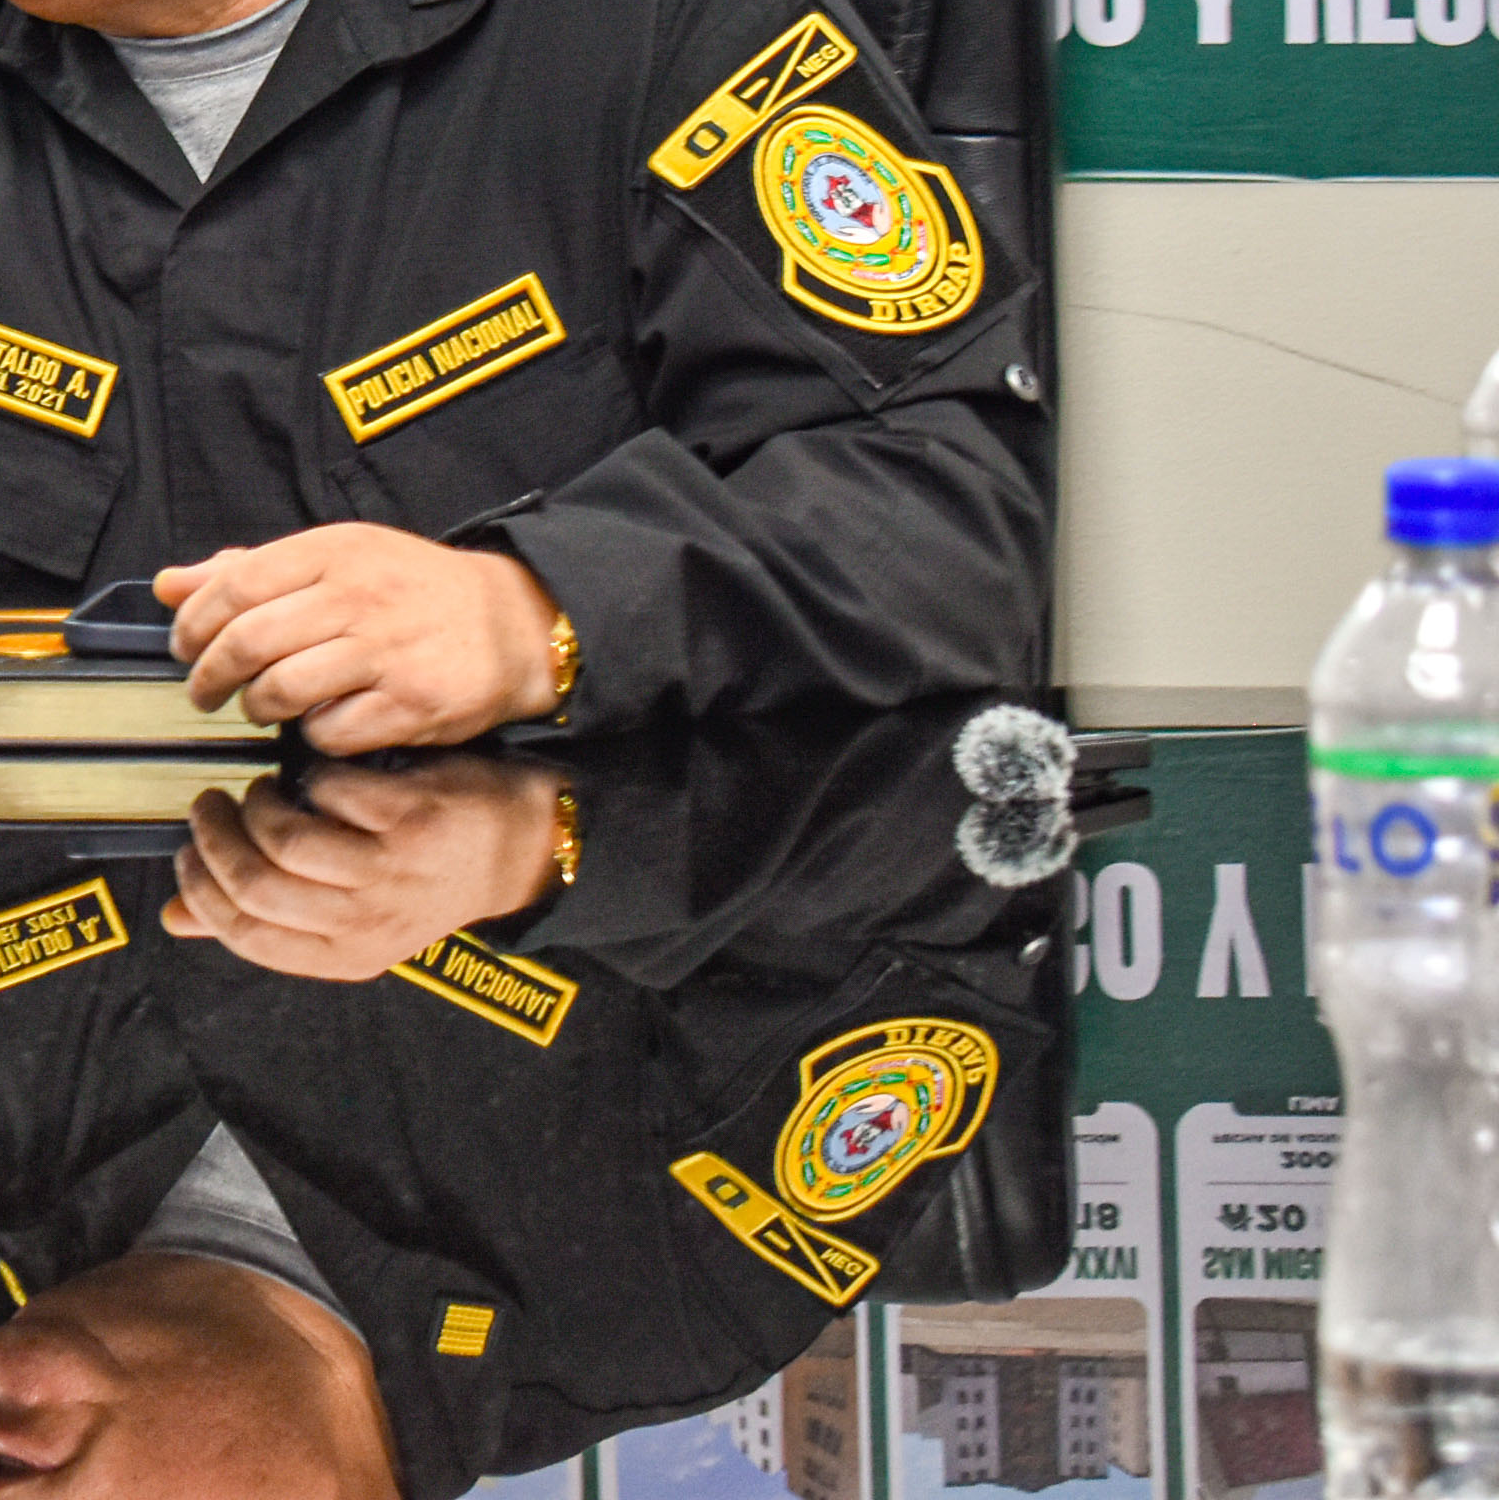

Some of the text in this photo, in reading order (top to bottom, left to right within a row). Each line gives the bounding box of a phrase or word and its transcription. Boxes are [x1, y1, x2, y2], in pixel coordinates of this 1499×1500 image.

[685, 43, 840, 159] O NEG
[868, 241, 971, 322] DIRBAP
[14, 379, 67, 412] 2021
[66, 370, 90, 399] A.
[346, 300, 544, 416] POLICIA NACIONAL
